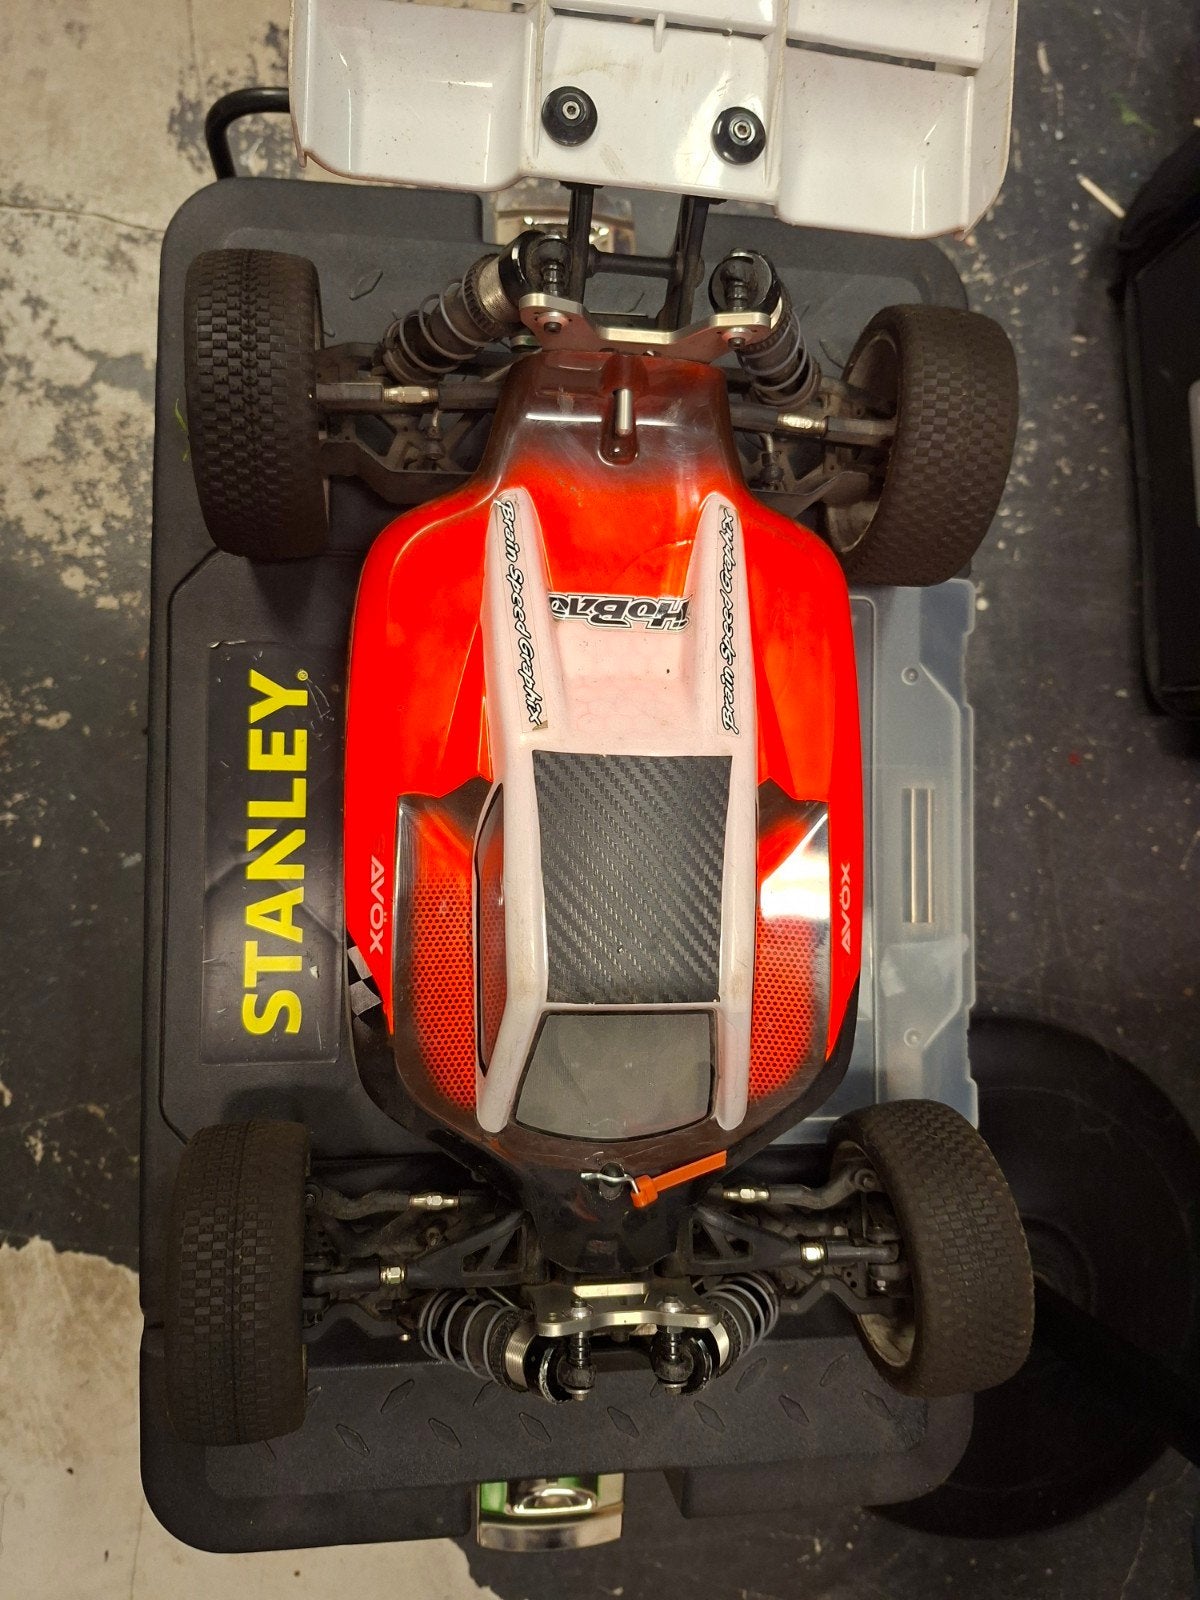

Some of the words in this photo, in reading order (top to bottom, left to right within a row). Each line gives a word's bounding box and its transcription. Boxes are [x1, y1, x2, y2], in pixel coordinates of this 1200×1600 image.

[495, 501, 520, 562] Brain
[719, 507, 735, 593] Graphix
[505, 564, 531, 639] Speed
[719, 591, 738, 665] Speed
[518, 638, 544, 726] Graphix
[720, 665, 739, 734] Brain
